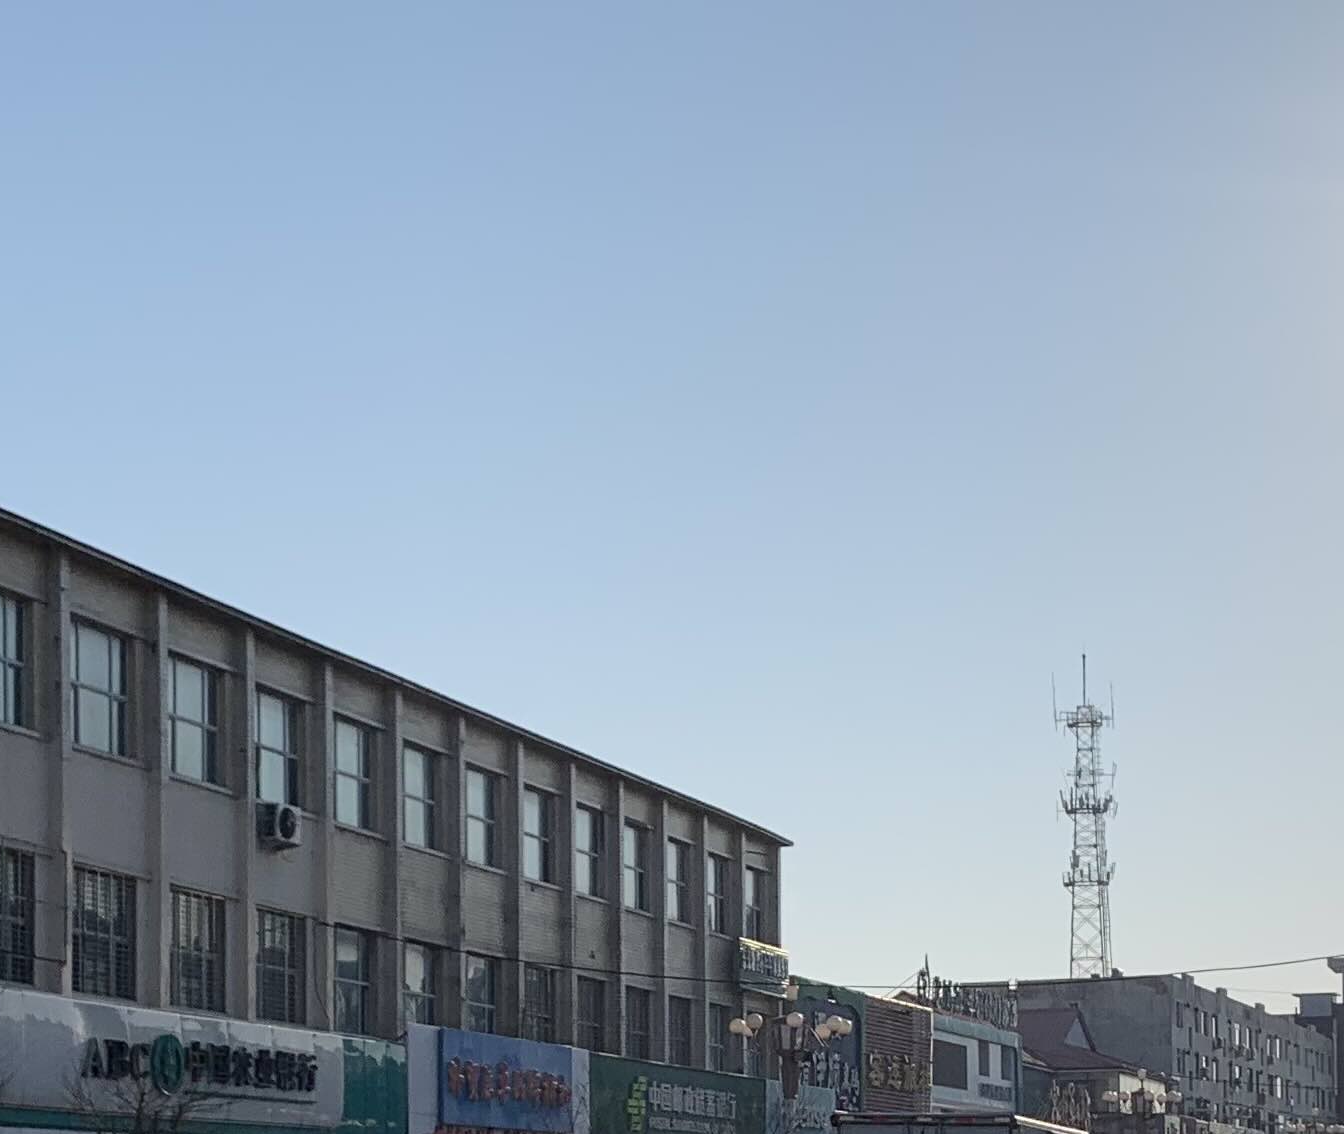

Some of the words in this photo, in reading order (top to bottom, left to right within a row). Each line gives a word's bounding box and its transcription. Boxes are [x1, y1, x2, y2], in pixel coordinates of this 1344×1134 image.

[81, 1037, 150, 1081] ABC
[185, 1040, 318, 1092] 中国农业银行
